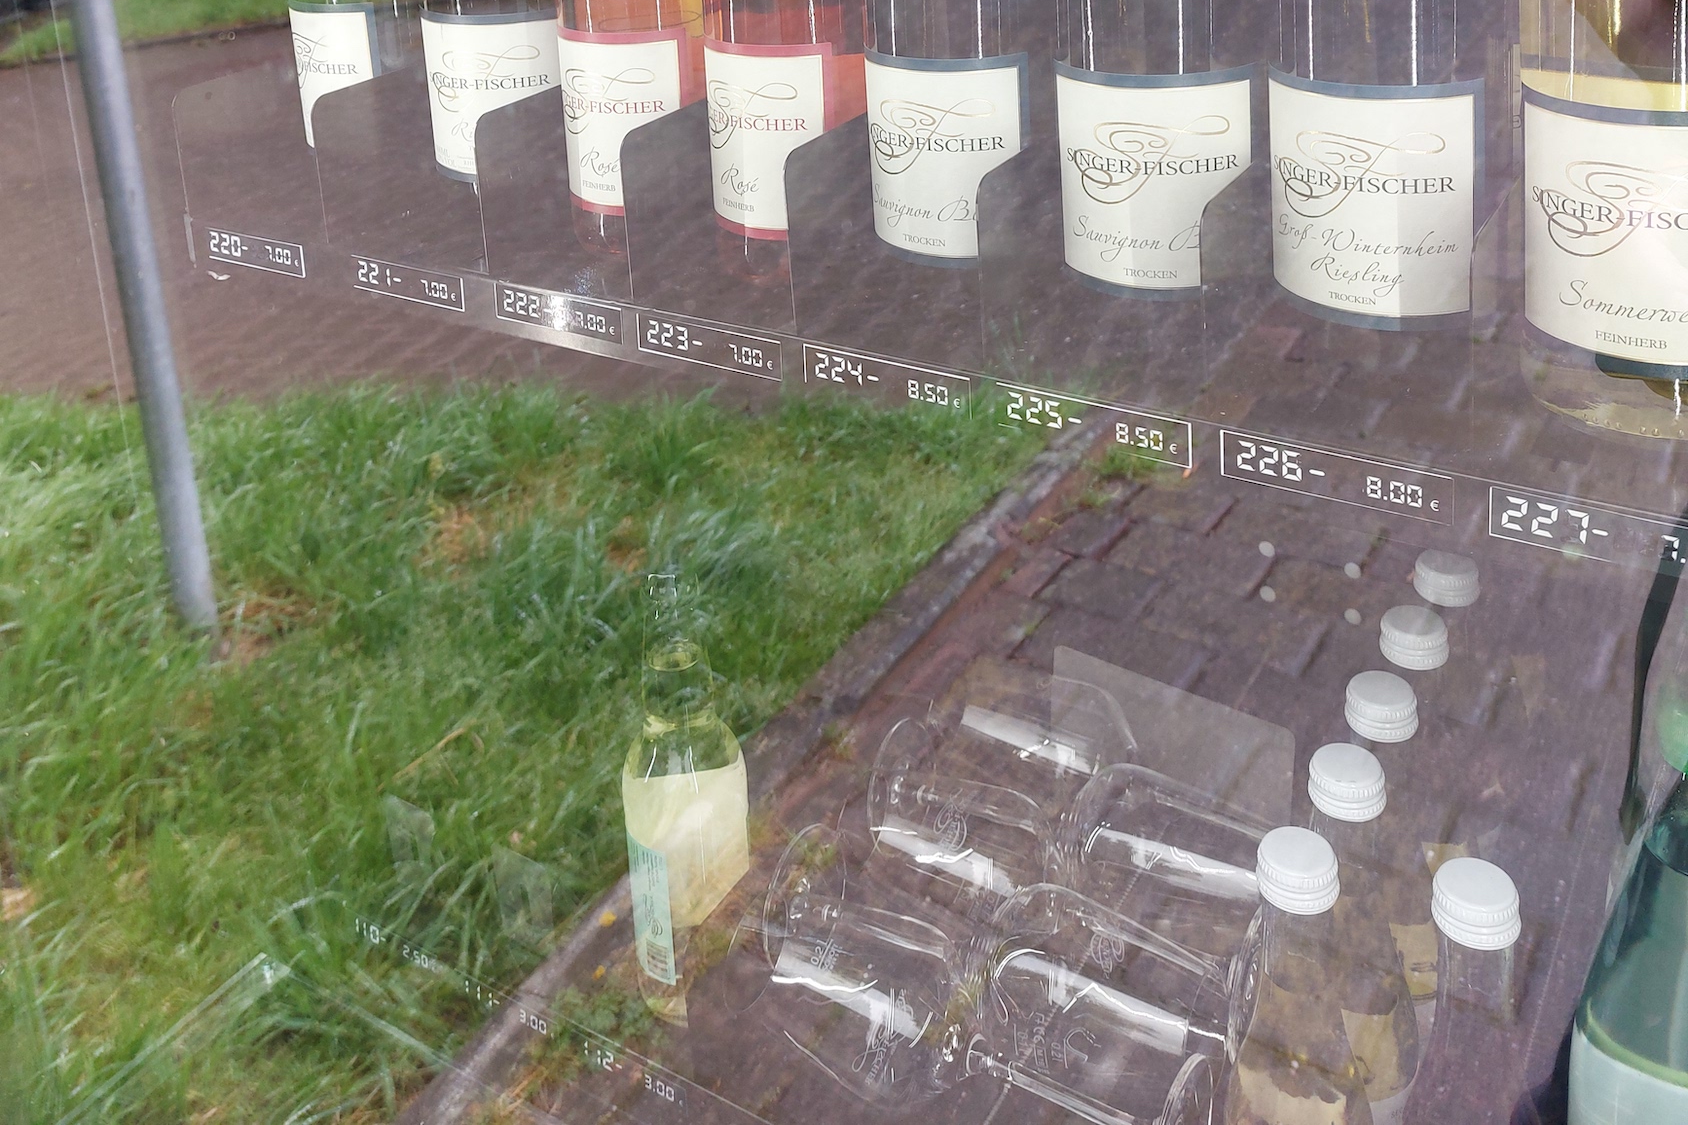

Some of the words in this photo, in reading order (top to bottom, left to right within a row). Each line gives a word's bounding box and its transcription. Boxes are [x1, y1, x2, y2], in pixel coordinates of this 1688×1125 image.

[580, 146, 620, 177] Rosé
[582, 179, 616, 192] FEINHERB
[721, 163, 759, 196] Rosé
[722, 197, 755, 212] FEINHERB
[874, 183, 935, 227] Sauvignon
[209, 231, 249, 257] 220-
[264, 245, 292, 266] 7.00
[902, 233, 946, 247] TROCKEN
[1072, 215, 1164, 262] Sauvignon
[357, 260, 402, 287] 221-
[420, 278, 448, 300] 7.00
[1123, 267, 1178, 279] TROCKEN
[1310, 252, 1405, 298] Riesling
[1328, 290, 1377, 306] TROCKEN
[575, 311, 606, 333] 7.00
[646, 320, 703, 351] 223-
[728, 343, 763, 368] 7.00
[1595, 329, 1668, 350] FEINHERB
[815, 352, 879, 386] 224-
[907, 379, 949, 406] 8.50
[1007, 391, 1082, 429] 225-
[1115, 422, 1163, 451] 8.50
[1236, 440, 1326, 482] 226-
[1366, 475, 1423, 508] 8.00
[1501, 495, 1609, 544] 227-
[402, 944, 428, 968] 2.50
[519, 1009, 547, 1035] 3.00
[644, 1074, 675, 1102] 3.00
